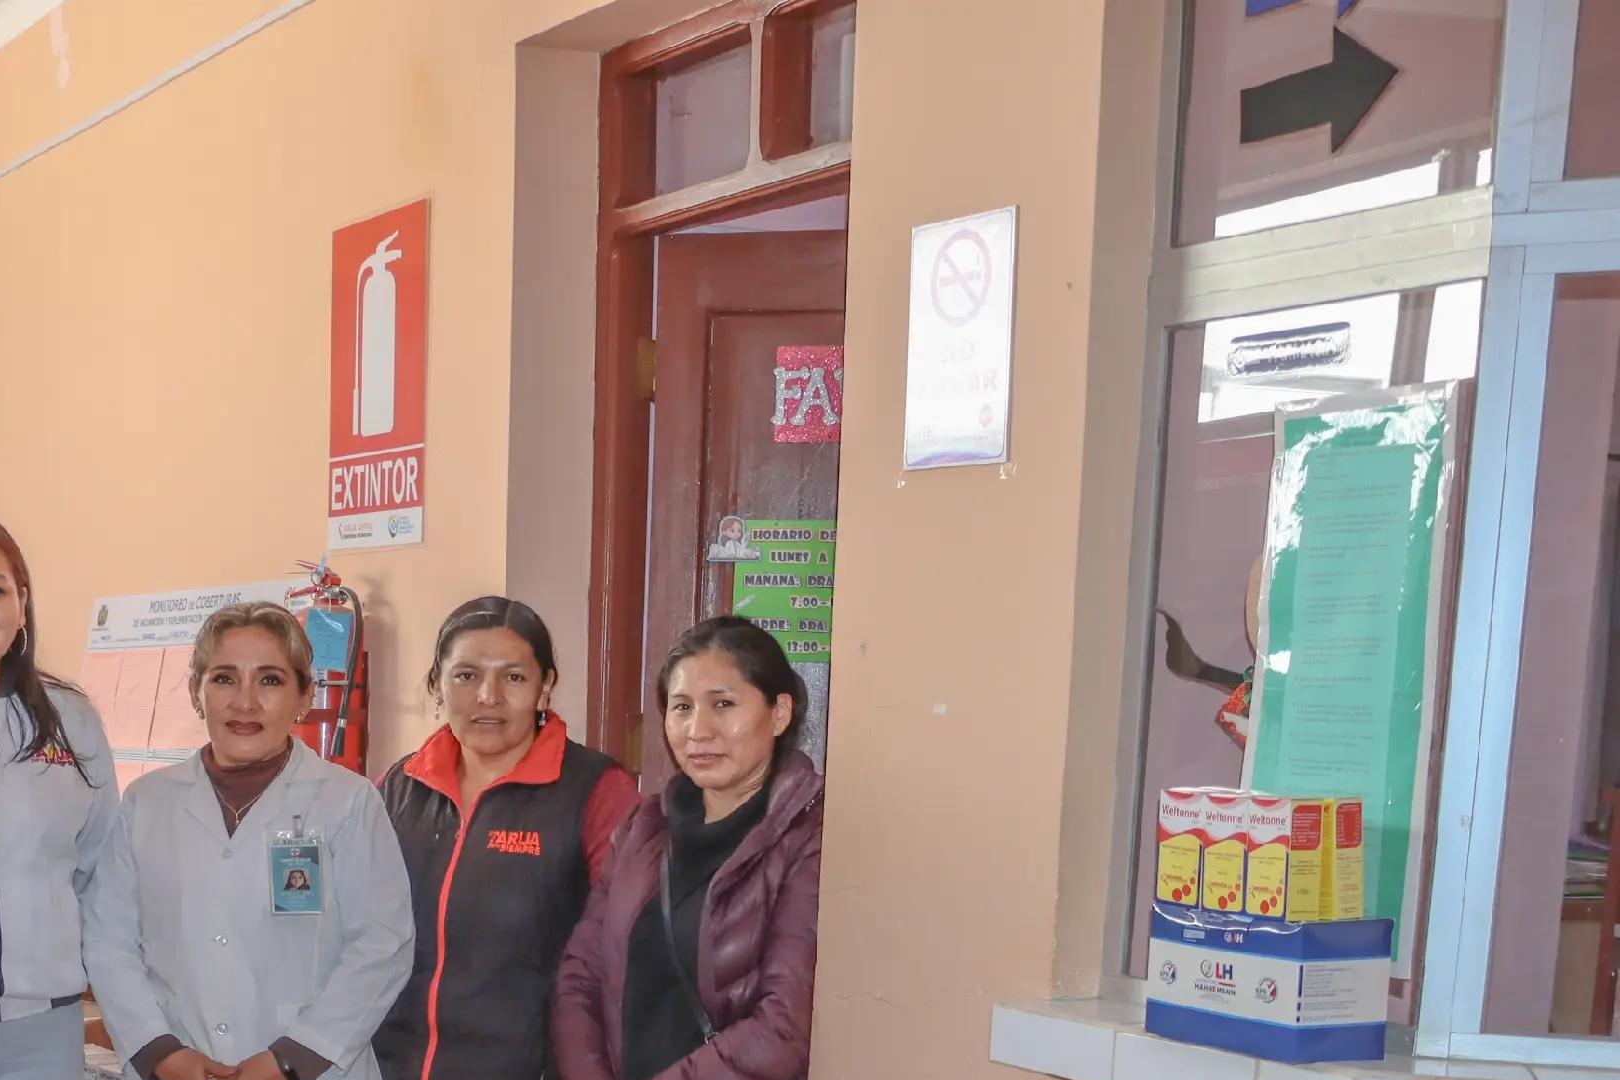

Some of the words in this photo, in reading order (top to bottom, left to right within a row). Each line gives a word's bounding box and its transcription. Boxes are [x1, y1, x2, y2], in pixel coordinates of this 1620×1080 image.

[771, 366, 843, 424] FA
[331, 456, 418, 511] EXTINTOR
[753, 529, 811, 541] HORARIO
[771, 551, 809, 562] LUNES
[818, 552, 828, 562] A
[149, 598, 188, 614] MONITOREO
[790, 596, 818, 608] 7:00
[754, 618, 790, 631] ARDE:
[1162, 804, 1200, 819] Weltonne
[1205, 810, 1243, 824] Weltonne
[1249, 814, 1286, 826] Weltonne
[488, 830, 540, 847] TARIJA
[1215, 961, 1233, 981] LH
